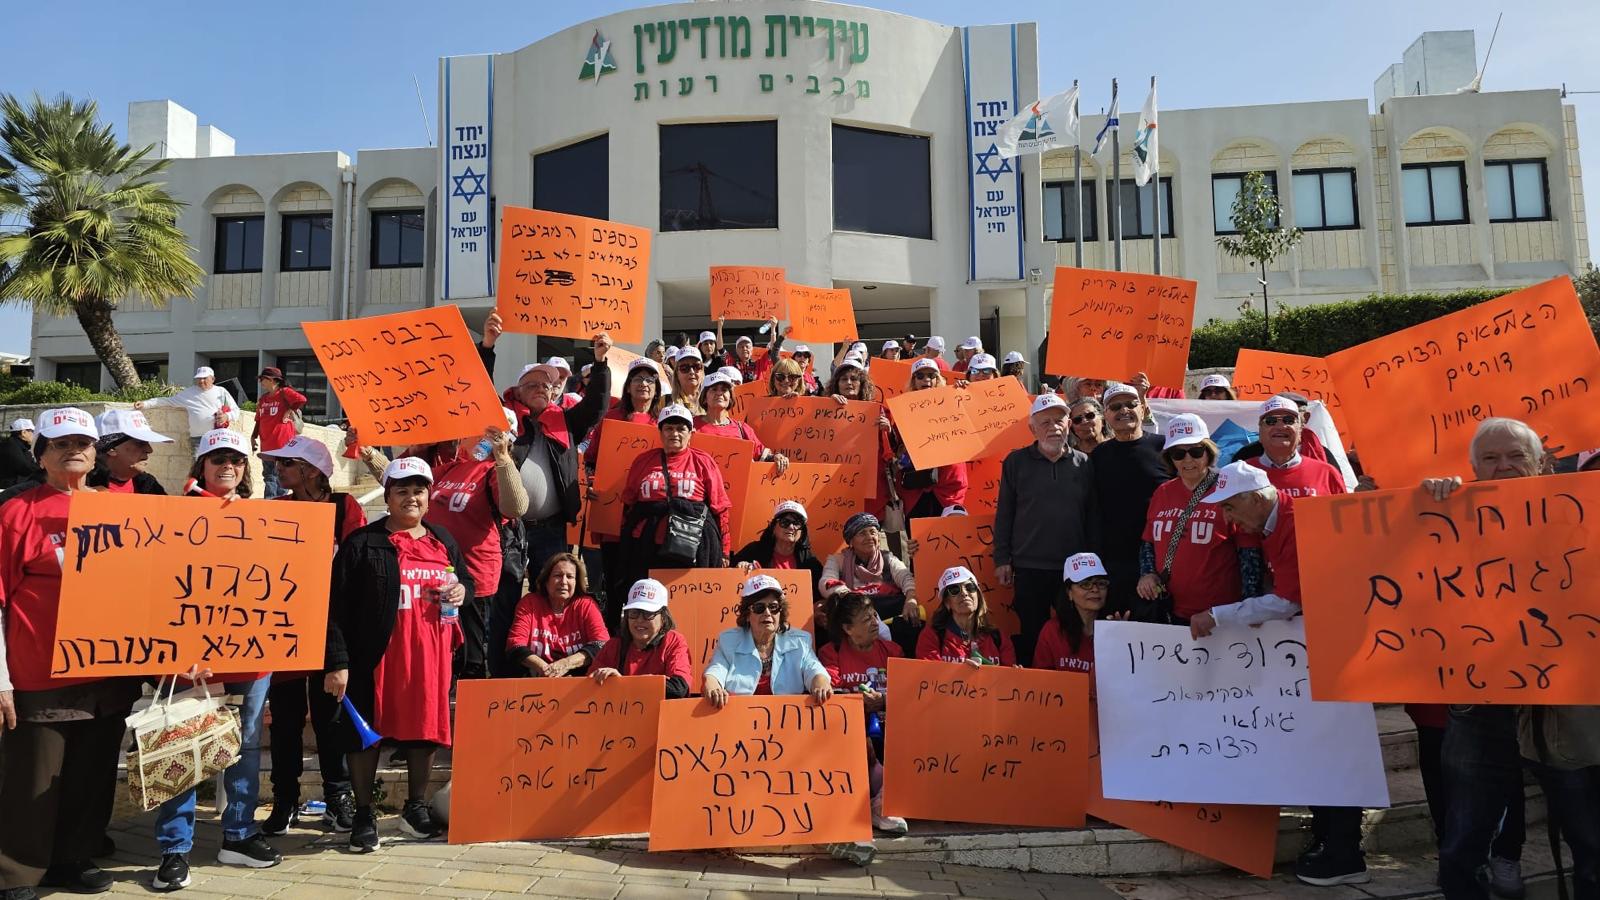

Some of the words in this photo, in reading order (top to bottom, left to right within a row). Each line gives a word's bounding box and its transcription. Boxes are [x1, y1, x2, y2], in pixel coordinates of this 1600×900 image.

[633, 16, 751, 73] מודיעין
[765, 15, 870, 63] עיריית
[634, 75, 718, 101] רעות
[759, 74, 870, 98] מכבים
[977, 101, 1007, 117] יחד
[455, 125, 483, 141] יחד
[452, 143, 487, 160] ננצח
[987, 190, 1004, 201] עם
[461, 211, 477, 222] עם
[976, 205, 1015, 219] ישראל
[451, 226, 487, 238] ישראל
[988, 221, 1006, 233] חי!
[461, 241, 477, 252] חי!
[592, 228, 638, 248] כספים
[521, 249, 545, 261] בני
[553, 248, 570, 260] לא
[588, 251, 638, 270] לגמלאים
[592, 273, 633, 290] ערובה
[515, 293, 531, 306] של
[541, 295, 553, 306] או
[570, 295, 630, 313] המדינה
[1147, 286, 1189, 304] גמלאים
[1456, 304, 1556, 351] הגמלאים
[385, 353, 455, 382] קיבוצי
[1362, 340, 1442, 388] הצוברים
[1446, 352, 1513, 392] דורשים
[443, 377, 471, 395] לא
[984, 384, 1006, 397] לא
[1521, 377, 1589, 414] רווחה
[448, 401, 481, 416] ולא
[955, 394, 972, 408] כך
[815, 407, 866, 423] הגמלאים
[793, 426, 835, 442] דורשים
[839, 472, 860, 487] לא
[1419, 493, 1584, 543] רווחה
[173, 563, 298, 602] לפגוע
[669, 582, 722, 599] הצוברים
[1364, 547, 1586, 615] לגמלאים
[1366, 607, 1600, 661] הצוברים
[1438, 664, 1559, 690] עכשיו
[1279, 678, 1307, 697] לא
[488, 693, 559, 719] הגמלאים
[997, 687, 1064, 708] רווחת
[575, 701, 644, 716] רווחת
[748, 704, 848, 735] רווחה
[517, 731, 578, 755] חובה
[982, 733, 1019, 748] חובה
[659, 733, 784, 781] לגמלאים
[913, 754, 961, 774] טובה
[568, 767, 608, 791] ולא
[982, 760, 1022, 782] ולא
[713, 769, 853, 797] הצוברים
[702, 803, 814, 837] עכשיו
